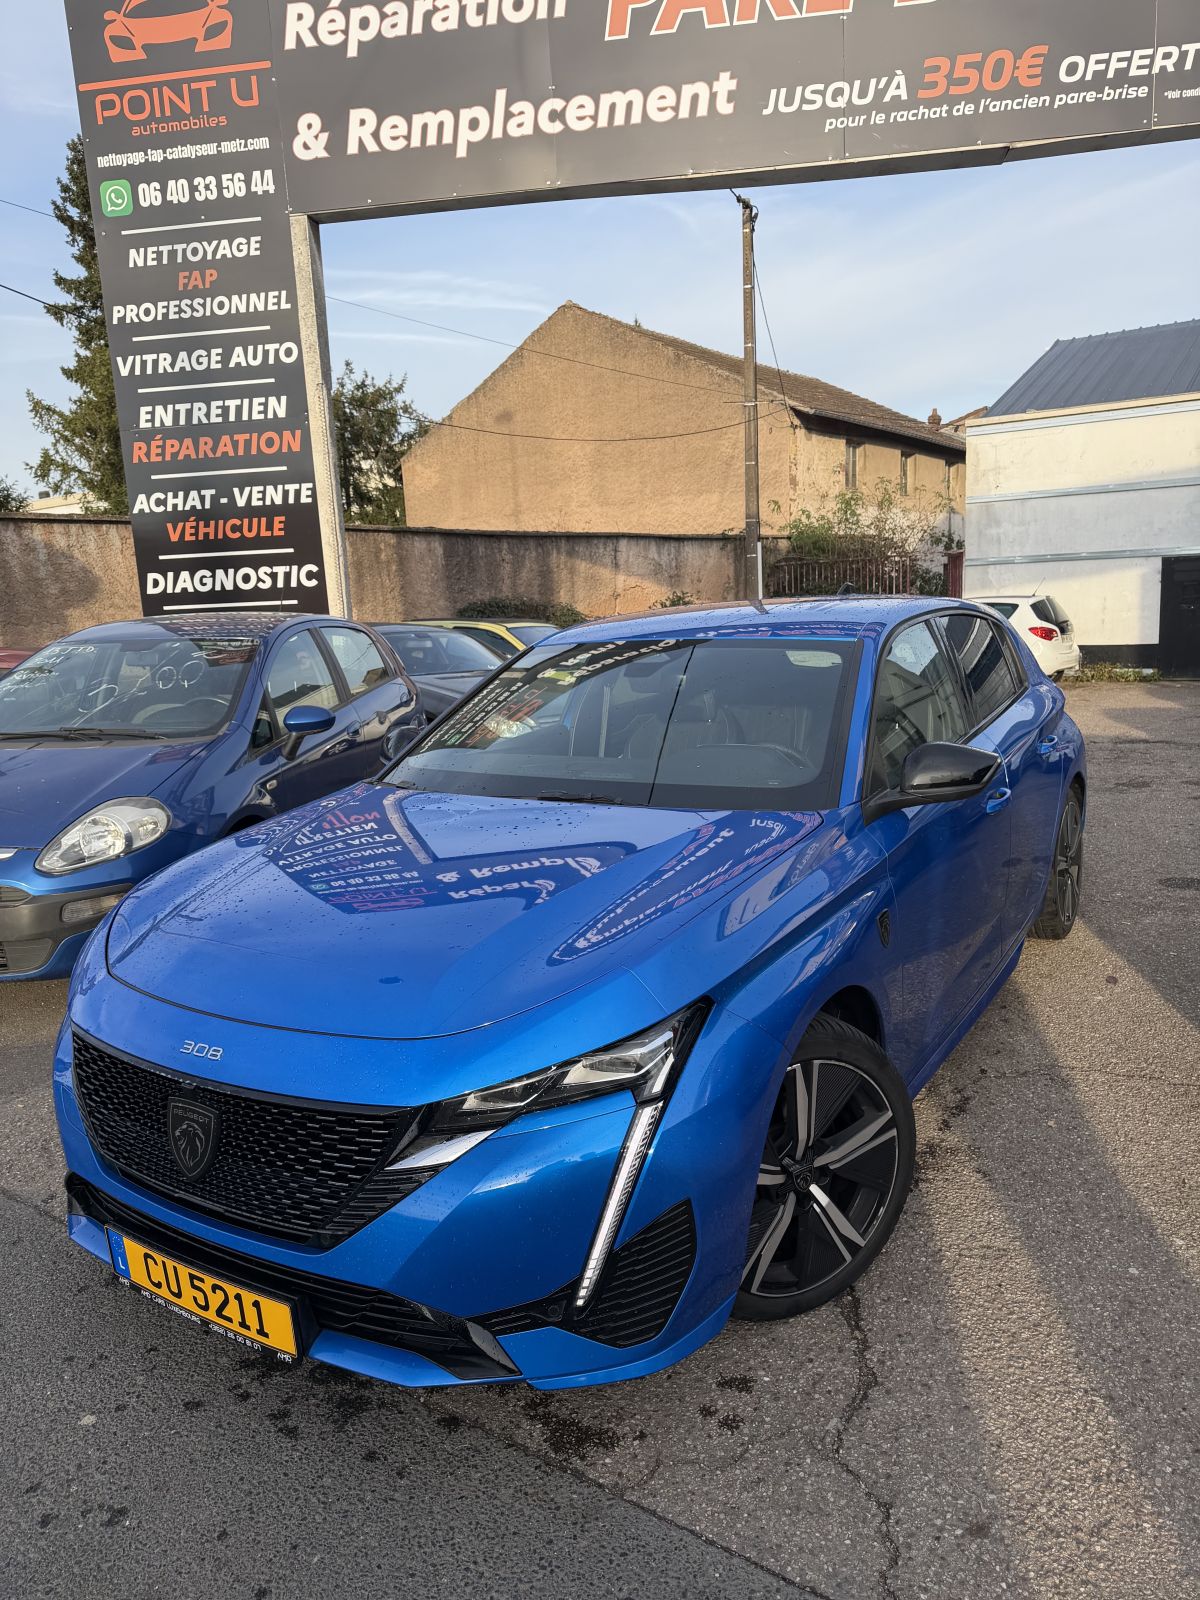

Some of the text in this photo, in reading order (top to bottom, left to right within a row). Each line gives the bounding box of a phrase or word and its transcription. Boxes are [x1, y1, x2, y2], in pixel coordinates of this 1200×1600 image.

[762, 42, 1200, 116] JUSQU'À 350€ OFFERT
[95, 75, 259, 125] POINT U
[291, 70, 738, 162] & Remplacement
[824, 84, 1149, 133] pour le rachat de l'ancien pare-brise
[131, 114, 228, 136] automobiles
[97, 137, 270, 168] nettoyage-fap-catalyseur-metz.com
[137, 169, 275, 208] 06 40 33 56 44
[128, 236, 262, 268] NETTOYAGE
[178, 269, 218, 291] FAP
[112, 290, 292, 325] PROFESSIONNEL
[116, 341, 299, 377] VITRAGE AUTO
[139, 395, 287, 428] ENTRETIEN
[132, 429, 302, 464] RÉPARATION
[132, 488, 216, 514] ACHAT
[232, 482, 313, 507] VENTE
[166, 515, 286, 542] VÉHICULE
[146, 563, 320, 595] DIAGNOSTIC
[180, 1040, 224, 1061] 308
[173, 1108, 210, 1124] PEUGEOT
[118, 1256, 128, 1270] L
